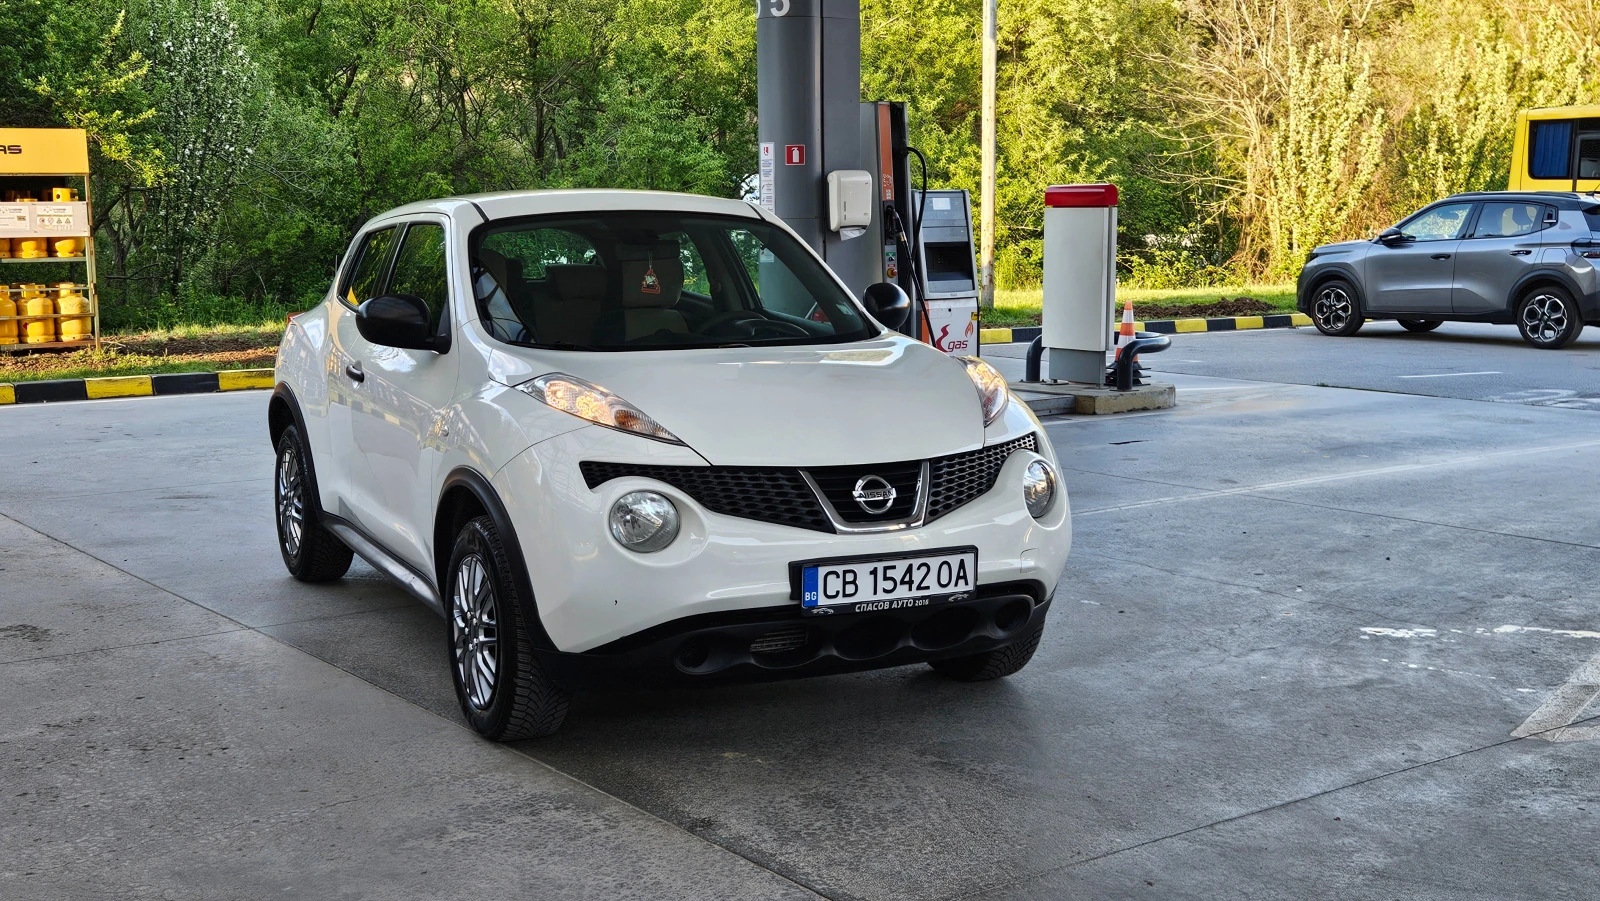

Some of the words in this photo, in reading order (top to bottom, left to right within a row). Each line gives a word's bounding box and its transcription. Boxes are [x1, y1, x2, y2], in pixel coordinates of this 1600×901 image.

[948, 340, 968, 352] gas
[859, 490, 893, 499] NISSAN
[823, 570, 859, 599] CB
[869, 562, 931, 596] 1542
[805, 591, 817, 601] BG
[855, 601, 889, 612] СПАСОВ
[891, 599, 914, 609] АУТО
